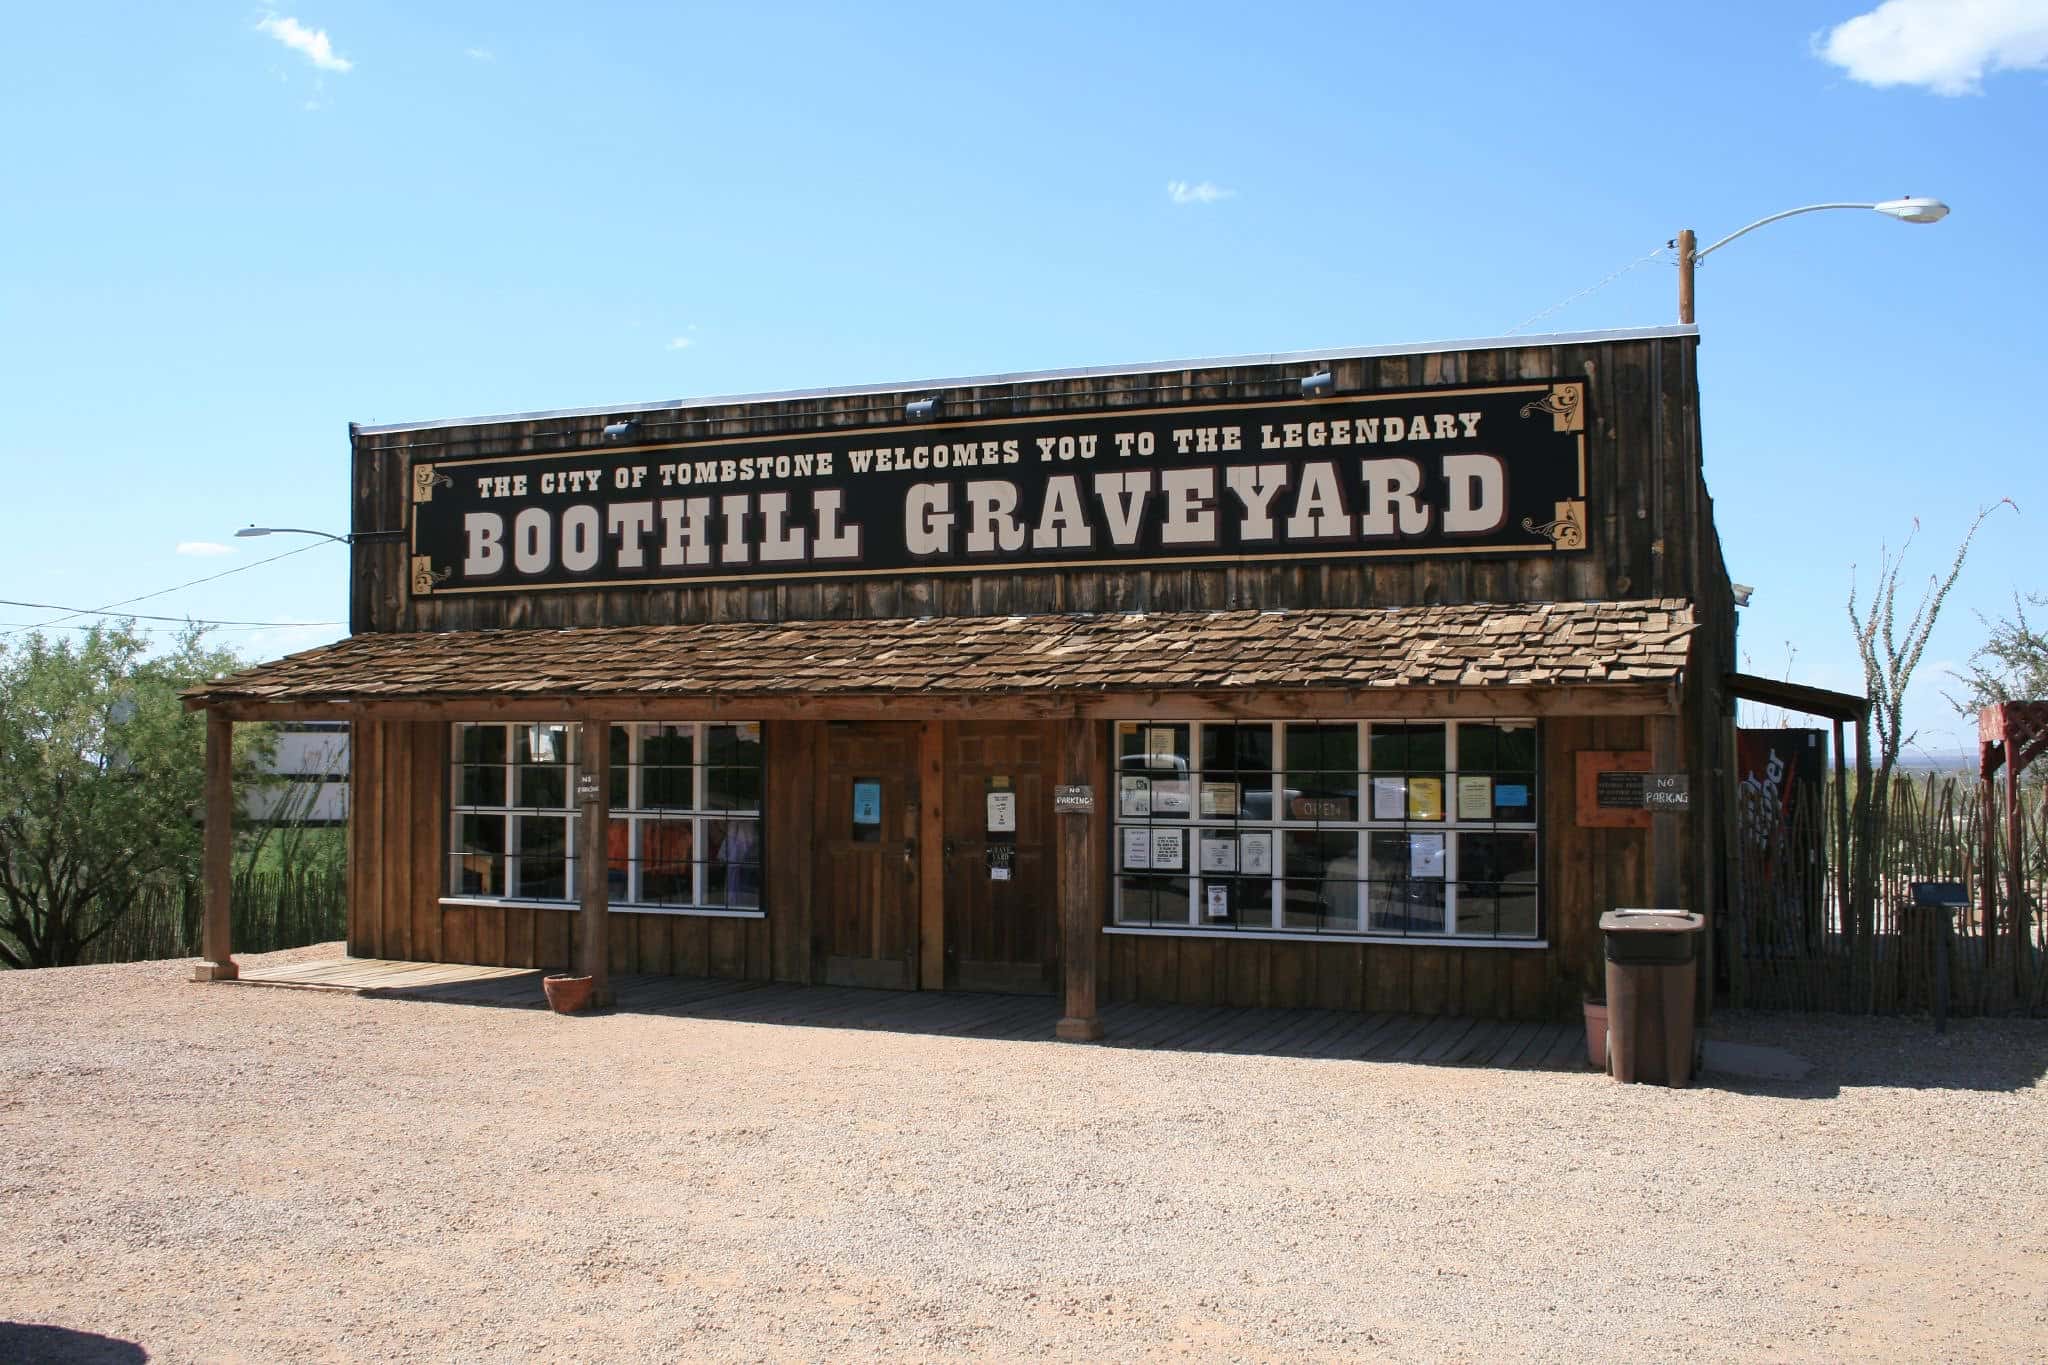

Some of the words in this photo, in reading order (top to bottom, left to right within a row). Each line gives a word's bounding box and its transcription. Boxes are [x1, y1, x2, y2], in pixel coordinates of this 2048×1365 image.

[479, 475, 528, 499] THE
[541, 470, 602, 494] CITY
[616, 467, 648, 489] OF
[660, 452, 833, 487] TOMBSTONE
[849, 439, 1020, 474] WELCOMES
[1036, 434, 1098, 462] YOU
[1115, 432, 1155, 457] TO
[1173, 426, 1242, 454] THE
[1262, 412, 1482, 450] LEGENDARY
[464, 489, 859, 577] BOOTHILL
[905, 454, 1505, 556] GRAVEYARD
[1657, 778, 1674, 788] NO
